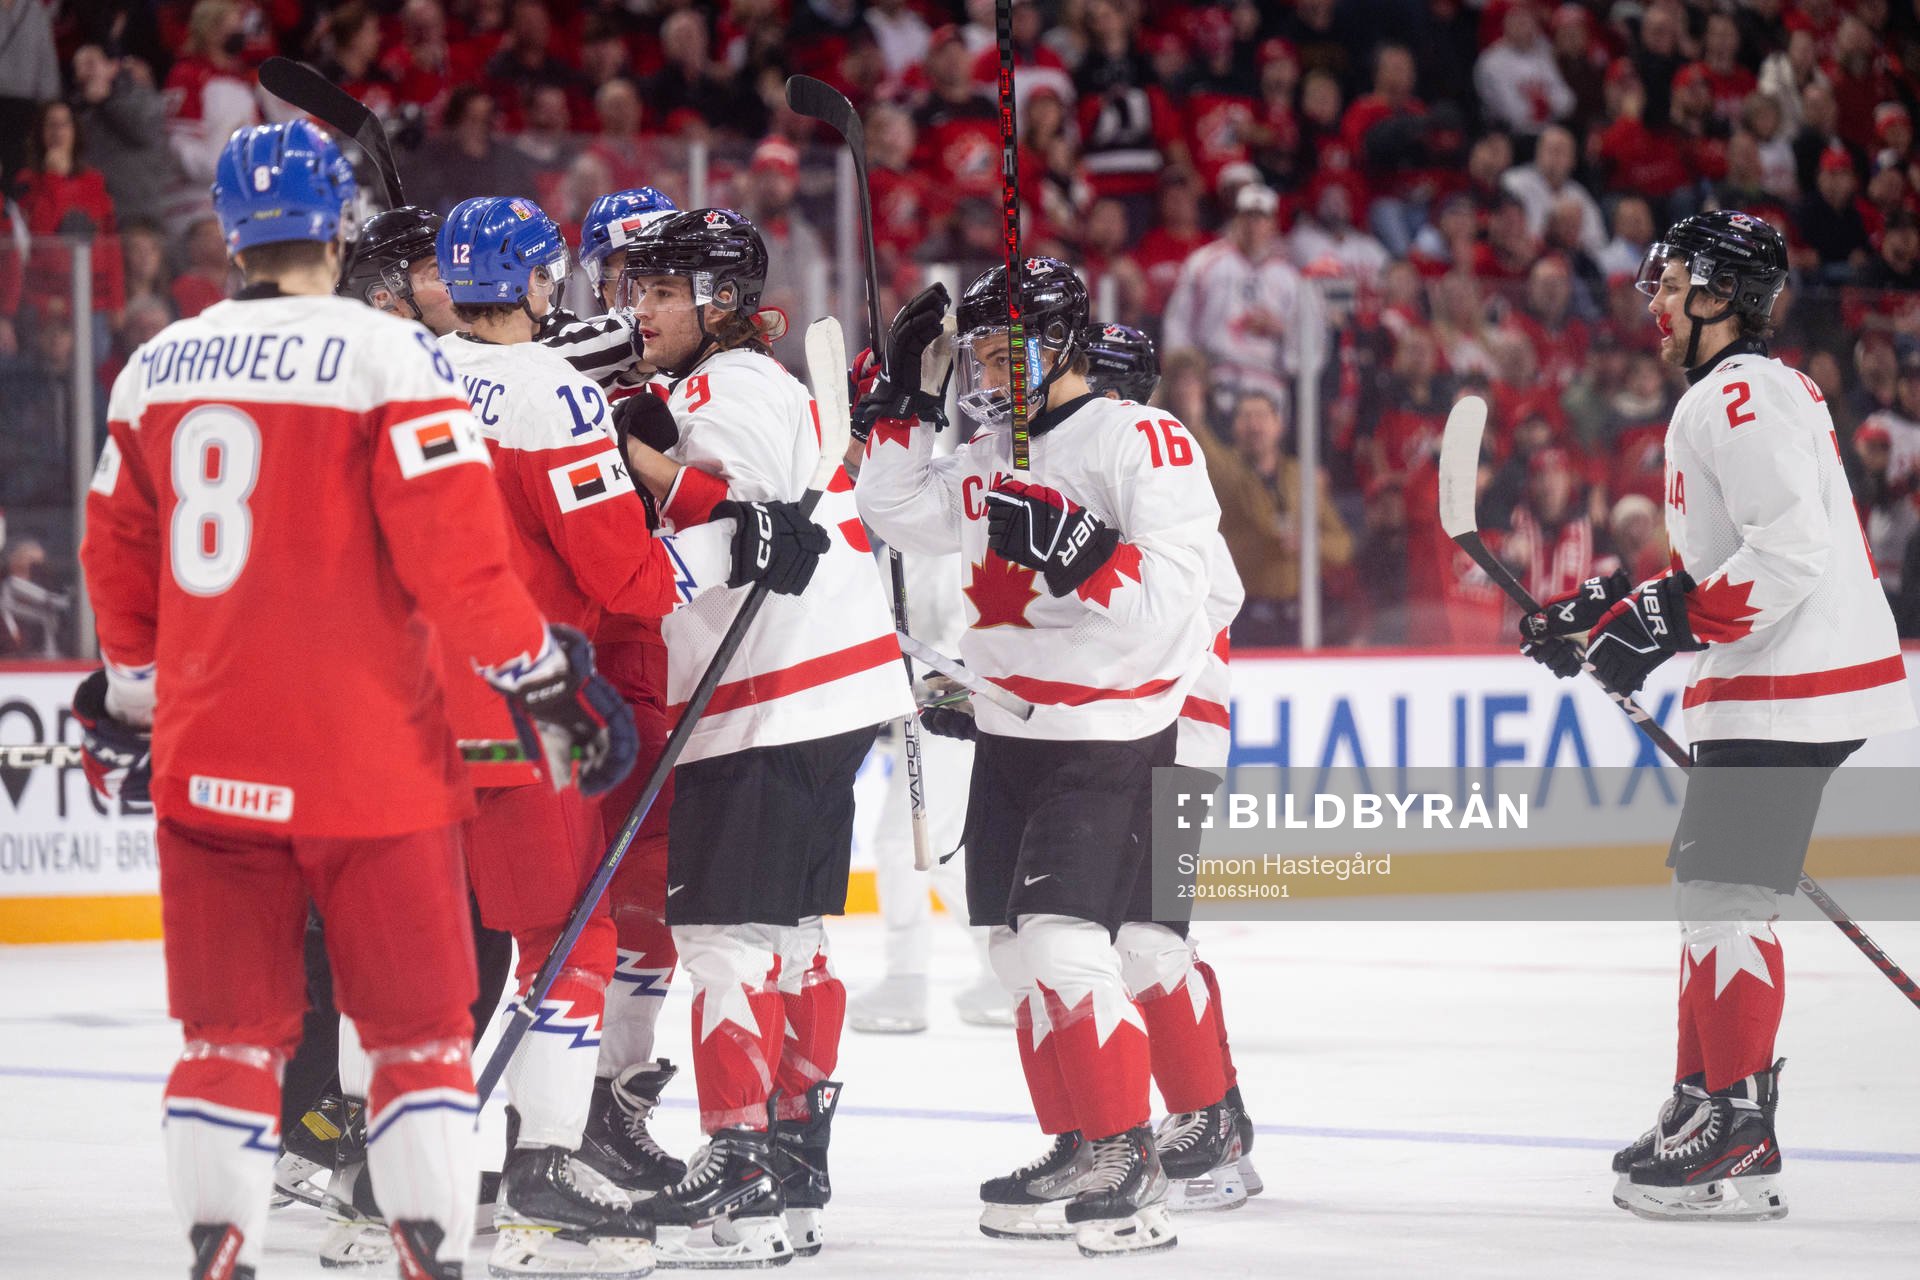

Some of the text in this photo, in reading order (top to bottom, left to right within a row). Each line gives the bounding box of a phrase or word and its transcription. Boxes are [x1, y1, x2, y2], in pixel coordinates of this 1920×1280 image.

[254, 165, 271, 192] 8
[453, 244, 470, 263] 12
[525, 241, 546, 257] CCM
[709, 250, 741, 258] BAUER
[141, 335, 346, 389] MORAVEC D
[414, 331, 455, 383] 8
[1028, 340, 1041, 385] BAUER
[556, 384, 606, 438] 12
[1722, 381, 1756, 429] 2
[1135, 418, 1194, 469] 16
[170, 404, 263, 597] 8
[0, 746, 82, 769] CM
[1225, 690, 1680, 818] HALIFAX
[216, 784, 283, 814] IIHF
[1730, 1143, 1767, 1177] CCM
